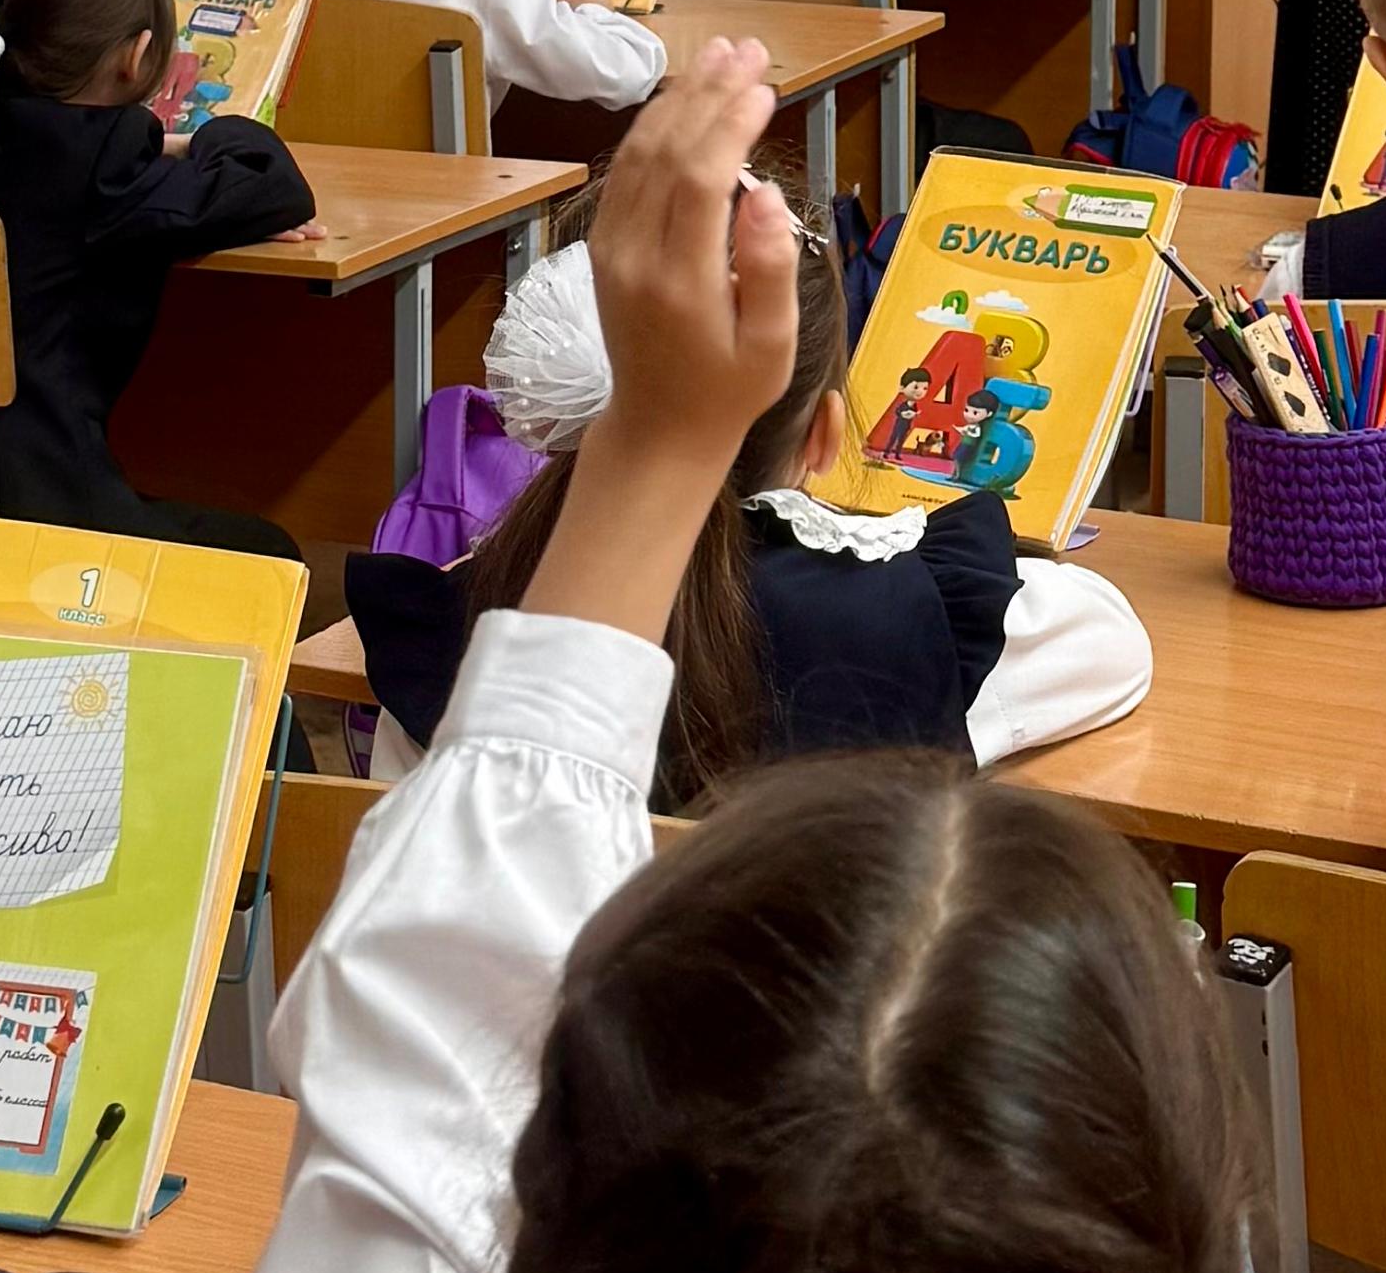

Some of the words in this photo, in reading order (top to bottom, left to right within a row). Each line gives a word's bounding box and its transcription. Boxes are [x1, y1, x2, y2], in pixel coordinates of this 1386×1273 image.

[938, 221, 1110, 275] БУКВАРЬ
[80, 568, 101, 608] 1
[57, 607, 107, 626] класс
